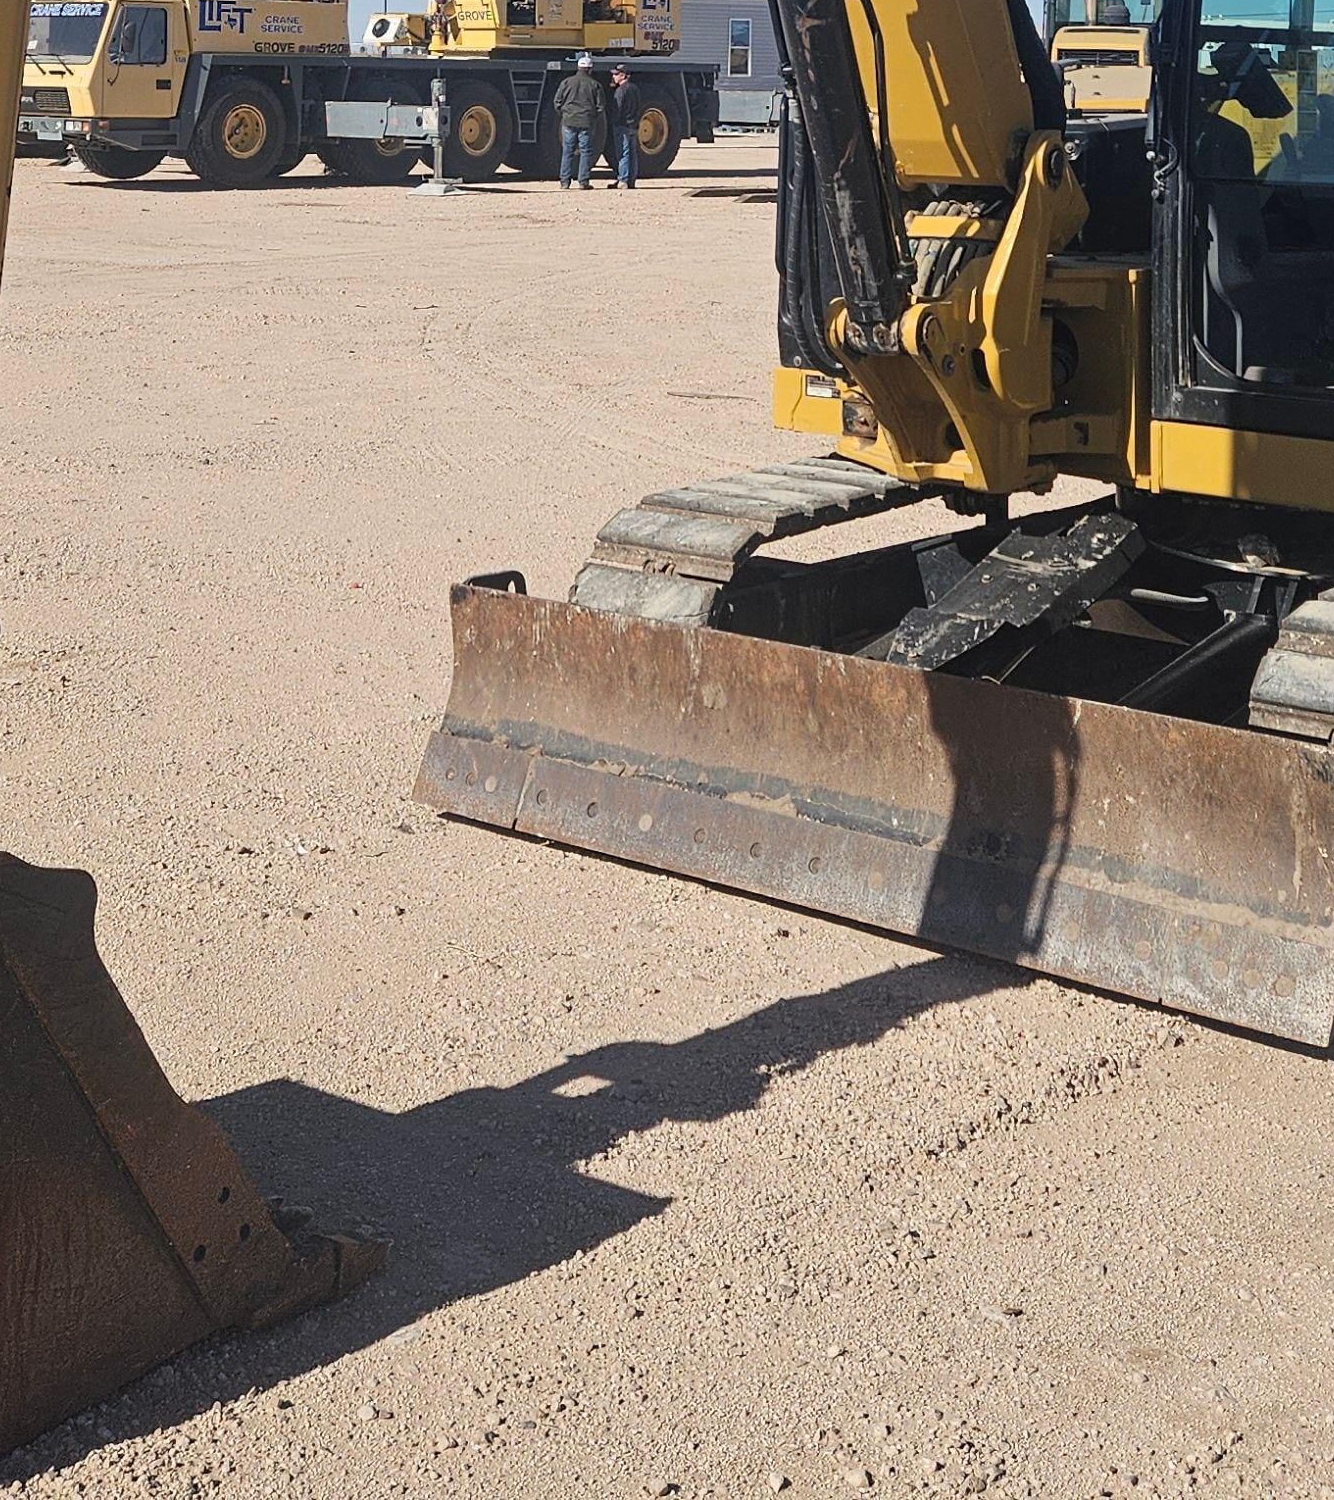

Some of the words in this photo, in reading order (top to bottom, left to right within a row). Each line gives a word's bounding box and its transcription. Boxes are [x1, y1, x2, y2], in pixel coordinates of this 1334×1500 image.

[62, 3, 104, 17] SERVICE
[199, 0, 252, 33] LIFT
[265, 15, 300, 24] CRANE
[458, 11, 493, 21] GROVE
[641, 15, 672, 23] CRANE
[261, 25, 303, 34] SERVICE
[638, 23, 674, 31] SERVICE
[254, 42, 295, 53] GROVE
